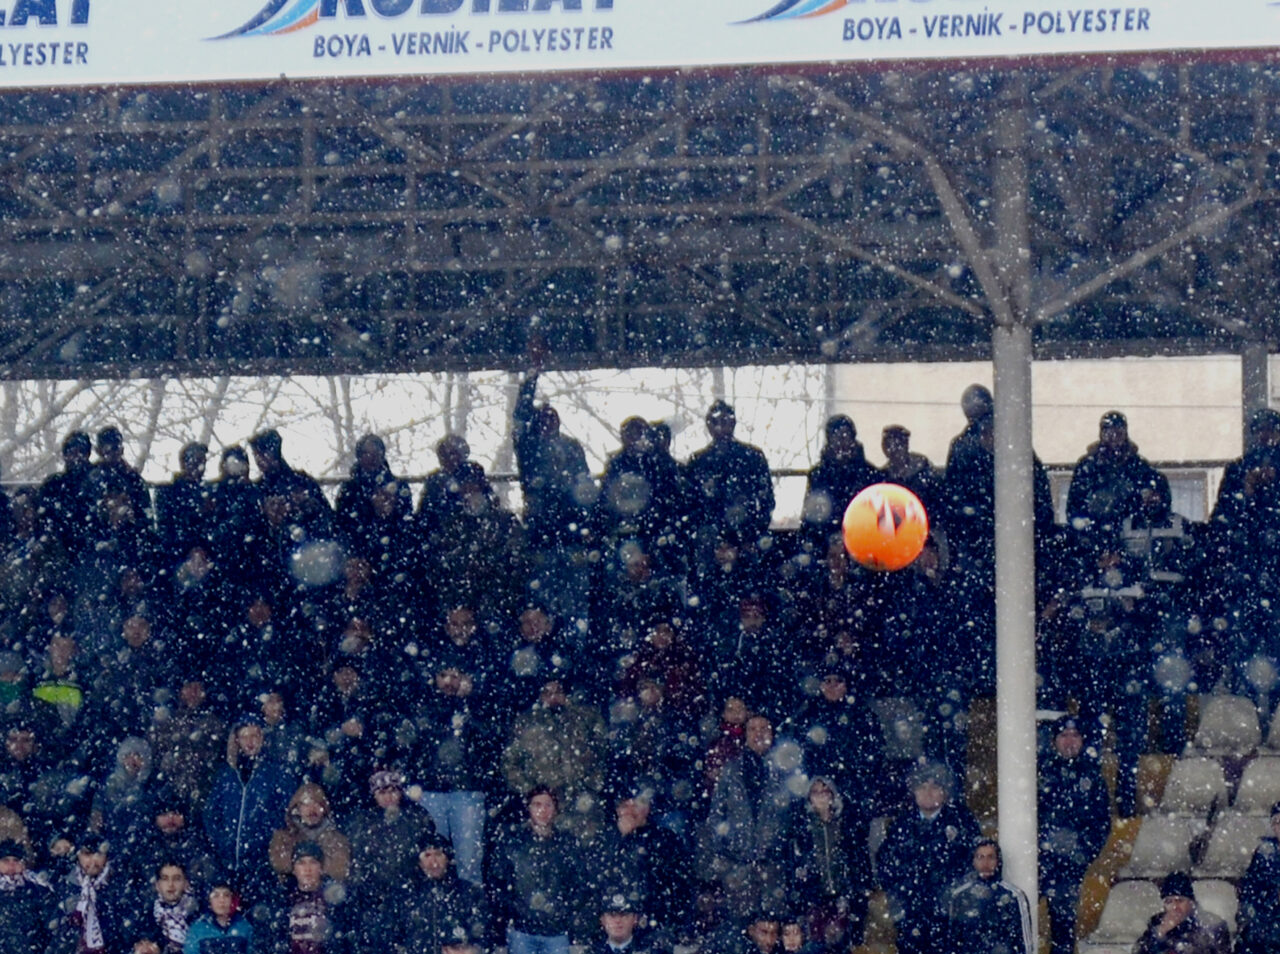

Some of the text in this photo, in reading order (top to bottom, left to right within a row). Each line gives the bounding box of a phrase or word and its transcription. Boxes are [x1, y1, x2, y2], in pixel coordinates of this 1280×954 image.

[842, 17, 902, 41] BOYA
[1022, 8, 1150, 35] POLYESTER
[313, 34, 371, 58] BOYA
[488, 26, 614, 53] POLYESTER
